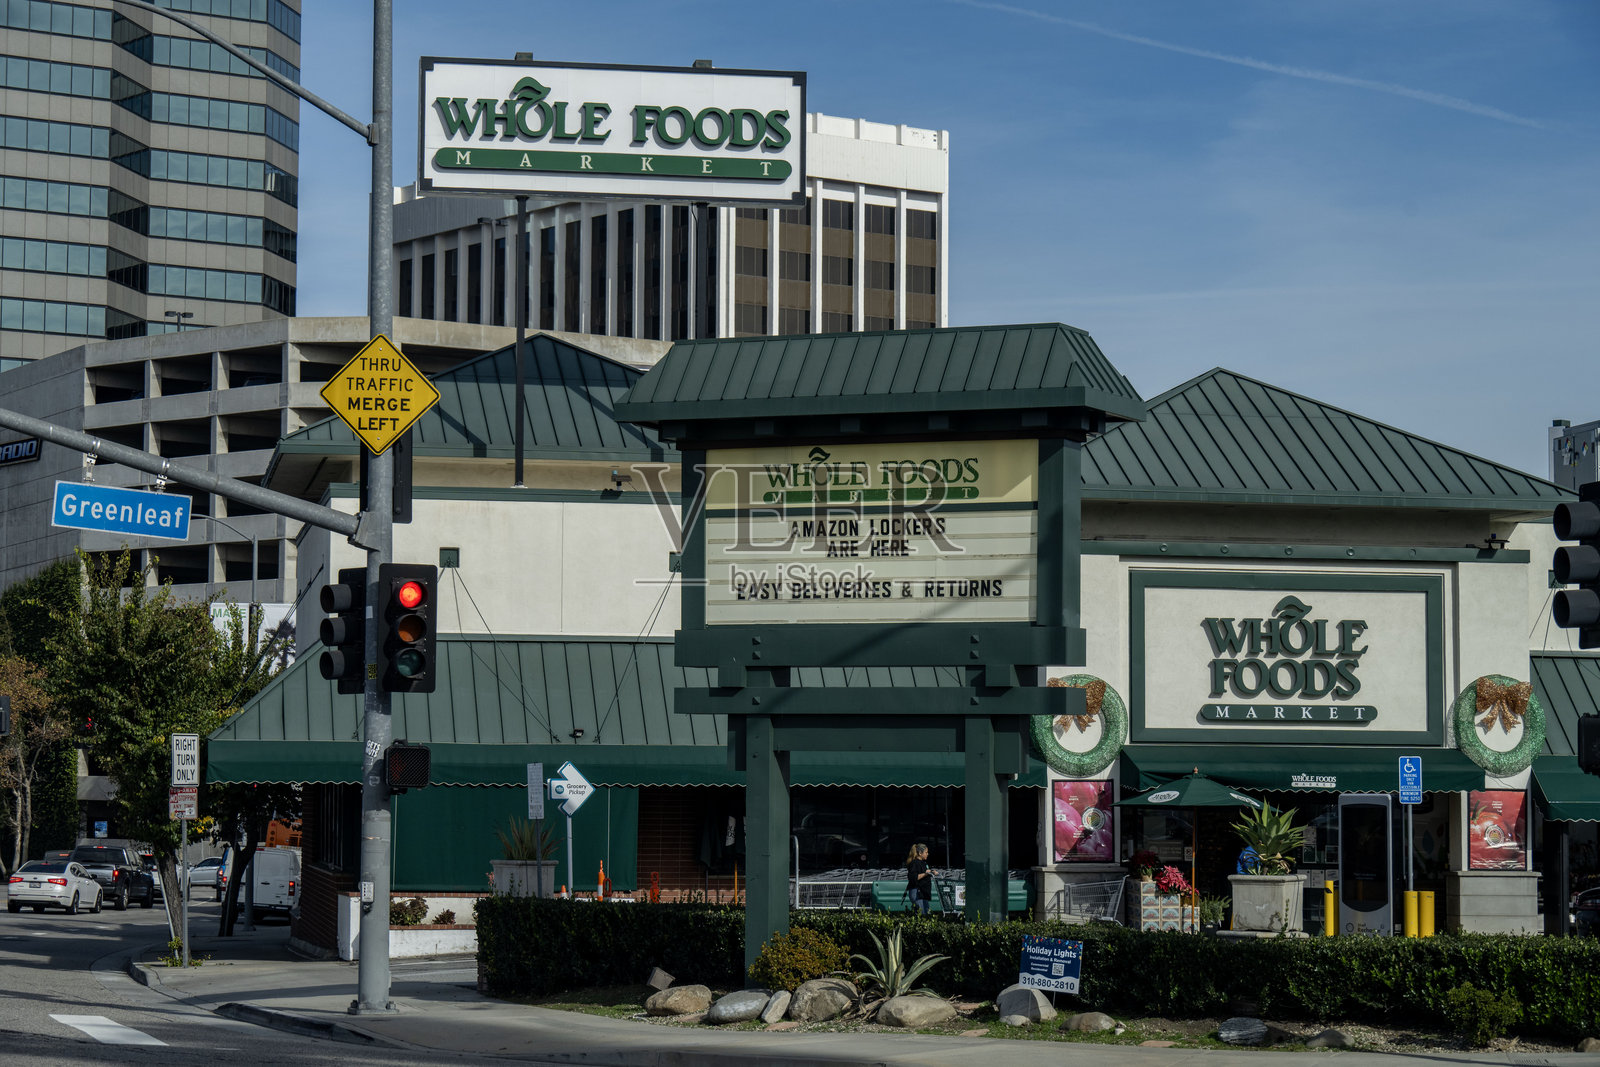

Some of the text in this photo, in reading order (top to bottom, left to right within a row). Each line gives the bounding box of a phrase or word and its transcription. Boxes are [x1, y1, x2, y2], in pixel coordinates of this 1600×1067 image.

[434, 95, 793, 149] WHOLE FOODS
[455, 150, 773, 176] MARKET
[359, 356, 402, 372] THRU
[345, 377, 414, 392] TRAFFIC
[347, 398, 411, 412] MERGE
[357, 417, 400, 431] LEFT
[0, 440, 37, 461] ADIO
[763, 457, 980, 488] WHOLE FOODS
[771, 486, 972, 504] MARKET
[61, 493, 184, 529] Greenleaf
[790, 517, 946, 538] AMAZON LOCKERS
[826, 539, 911, 558] ARE HERE
[736, 579, 1004, 600] EASY DELIVERIES & RETURNS
[213, 608, 247, 619] MAE
[1202, 616, 1369, 657] WHOLE
[1210, 658, 1363, 698] FOODS
[1215, 705, 1367, 720] MARKET
[175, 738, 196, 751] RIGHT
[176, 753, 196, 766] TURN
[176, 769, 196, 781] ONLY
[1291, 774, 1337, 783] WHOLE FOODS
[1026, 945, 1077, 959] Holiday Lights
[1022, 977, 1074, 990] 310-880-2810
